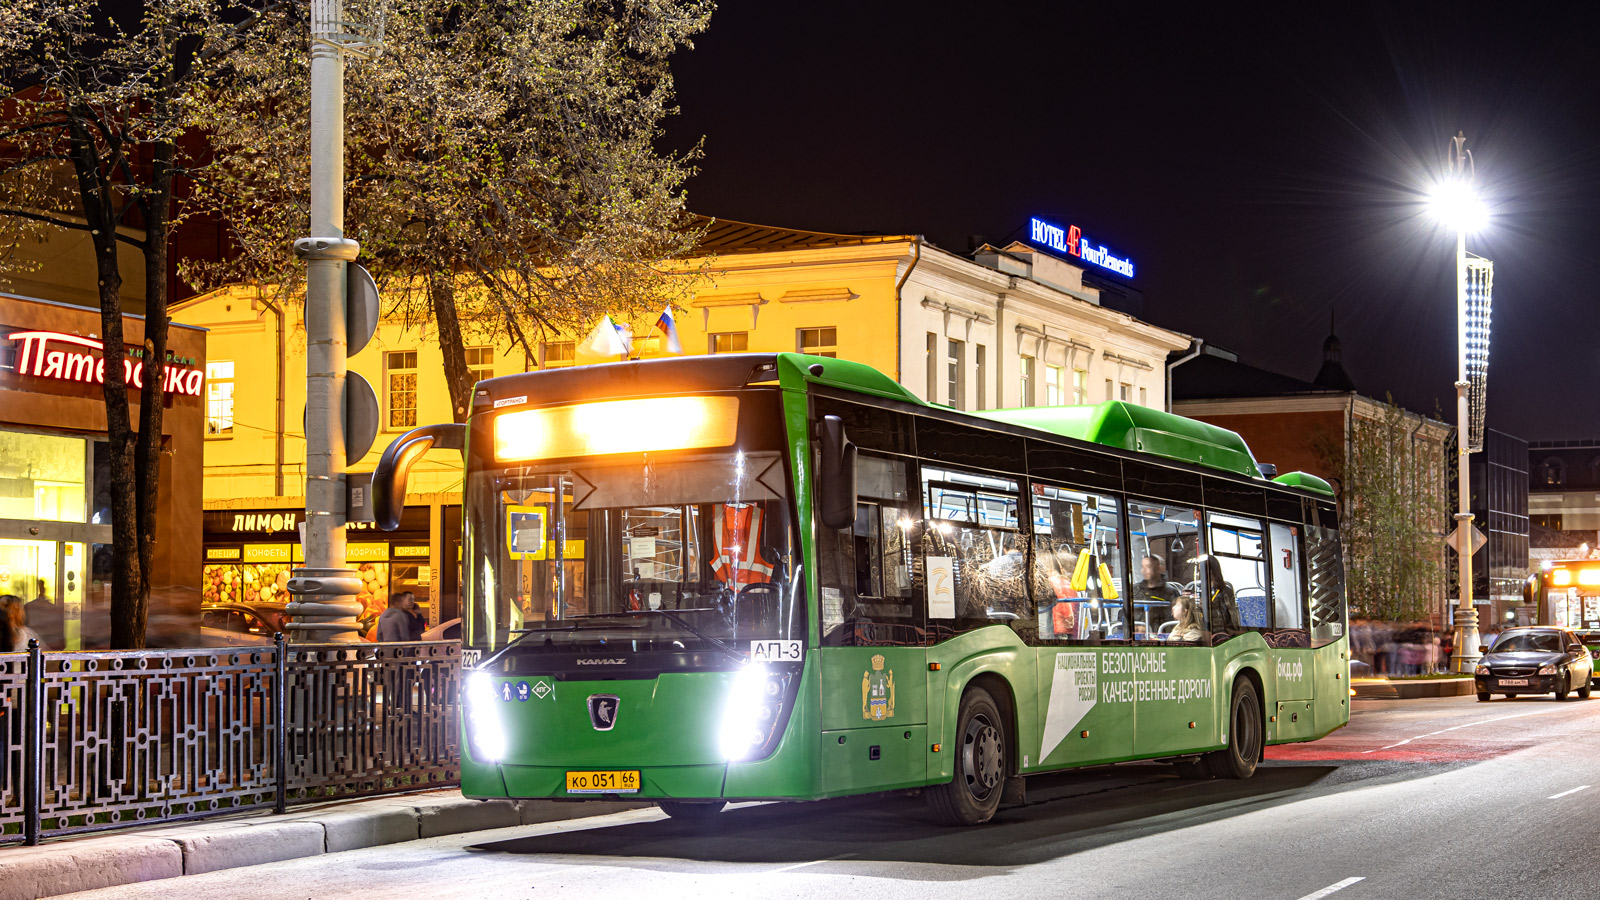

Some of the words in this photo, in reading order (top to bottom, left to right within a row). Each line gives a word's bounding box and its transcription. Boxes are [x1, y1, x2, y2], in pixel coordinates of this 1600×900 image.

[1031, 218, 1066, 252] HOTEL
[129, 348, 196, 365] УНРСАМ
[231, 513, 296, 532] ЛИМОН
[207, 549, 240, 558] СПЕЦИИ
[247, 549, 288, 557] КОНФЕТЫ
[346, 548, 388, 557] УХОФРУКТЫ
[398, 547, 427, 555] ОРЕХИ
[754, 643, 800, 658] АП-3
[1057, 654, 1096, 671] НАЦИОНАЛЬНЫЕ
[1102, 652, 1167, 674] БЕЗОПАСНЫЕ
[1277, 657, 1303, 682] бкд.рф
[1074, 671, 1096, 685] ПРОЕКТЫ
[1078, 687, 1096, 701] РОССИИ
[1102, 680, 1177, 703] КАЧЕСТВЕННЫЕ
[1177, 679, 1211, 704] ДОРОГИ
[572, 777, 587, 787] КО
[592, 774, 615, 787] 051
[622, 772, 635, 783] 66
